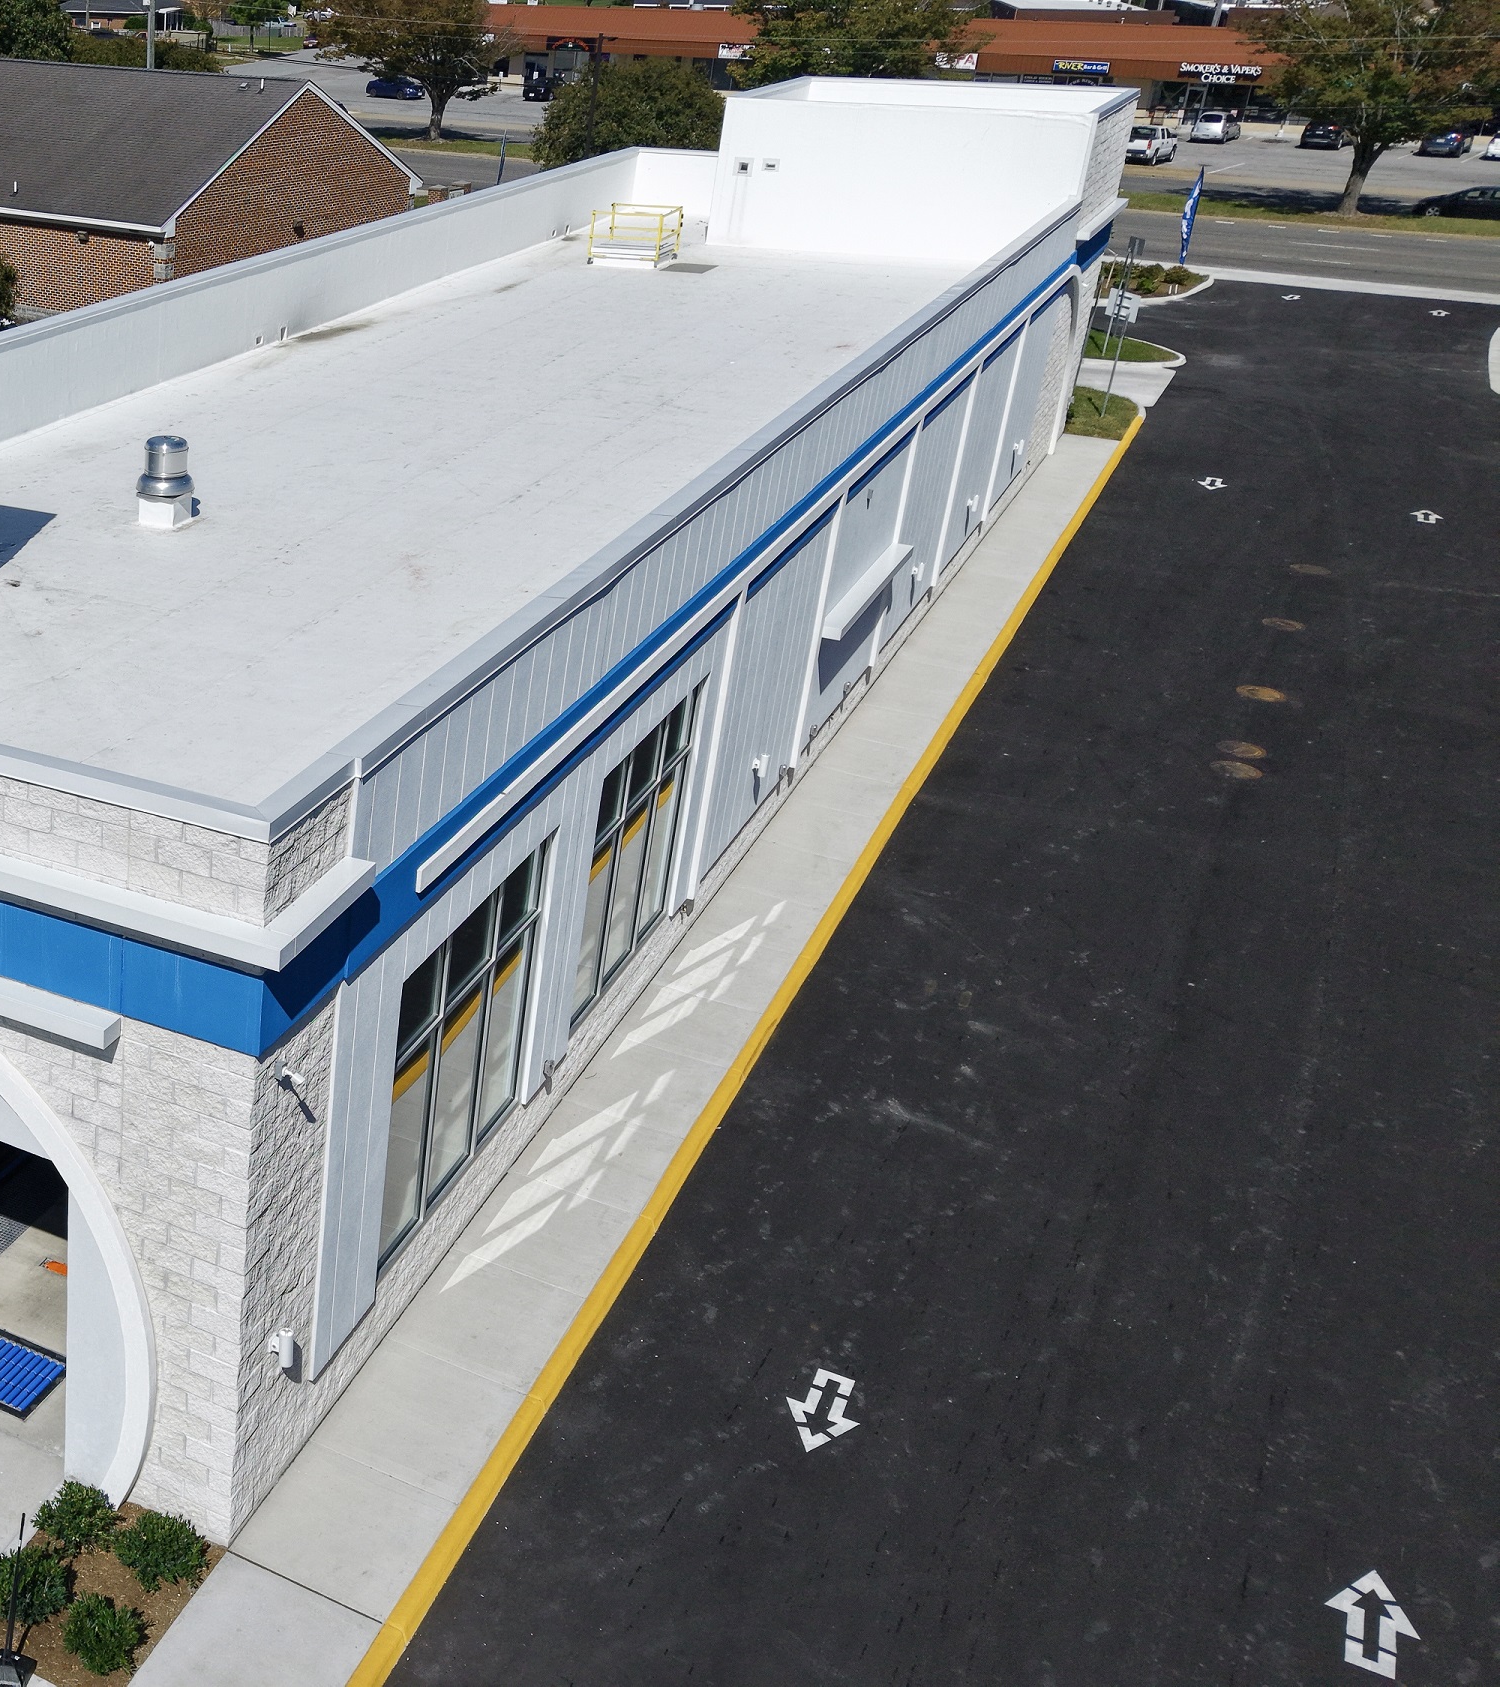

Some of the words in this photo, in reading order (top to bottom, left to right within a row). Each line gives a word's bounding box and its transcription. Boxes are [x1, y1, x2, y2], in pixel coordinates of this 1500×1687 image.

[1058, 61, 1084, 70] RIVER
[1180, 62, 1221, 74] SMOKER'S
[1222, 65, 1229, 73] &
[1231, 64, 1262, 76] VAPER'S
[1201, 73, 1236, 83] CHOICE
